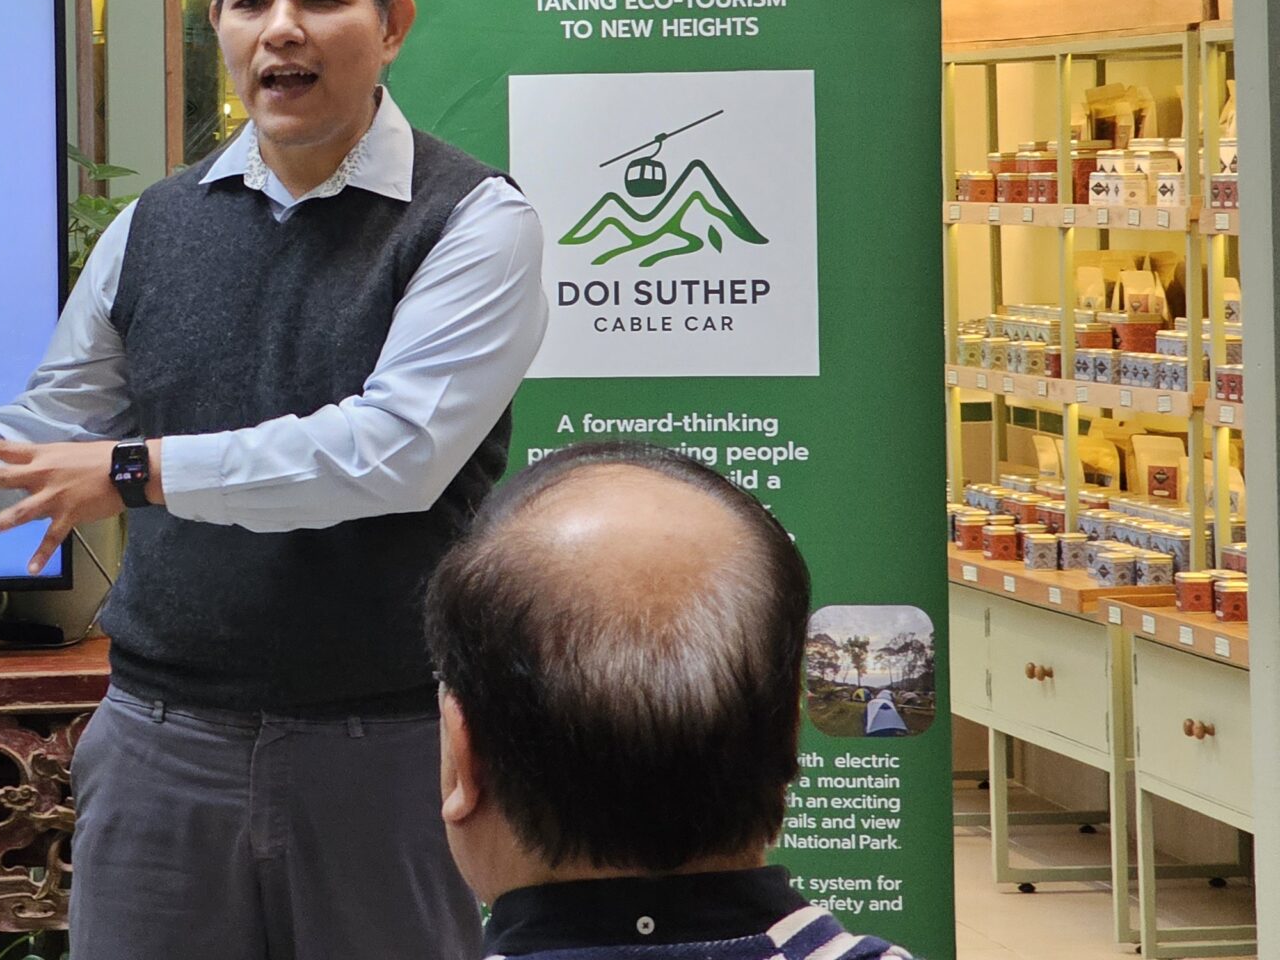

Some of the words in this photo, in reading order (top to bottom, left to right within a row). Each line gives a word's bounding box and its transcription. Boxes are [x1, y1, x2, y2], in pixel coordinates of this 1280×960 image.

[560, 20, 593, 39] TO
[601, 19, 654, 38] NEW
[662, 17, 759, 37] HEIGHTS
[558, 280, 620, 306] DOI
[634, 279, 771, 305] SUTHEP
[593, 316, 673, 332] CABLE
[684, 316, 734, 332] CAR
[557, 415, 574, 433] A
[583, 412, 779, 437] forward-thinking
[726, 441, 809, 465] people
[767, 473, 782, 490] a
[834, 753, 900, 768] electric
[799, 776, 811, 788] a
[817, 774, 900, 788] mountain
[806, 796, 828, 808] an
[831, 794, 901, 812] exciting
[782, 813, 817, 829] rails
[821, 814, 856, 829] and
[861, 815, 901, 829] view
[784, 833, 855, 849] National
[859, 834, 902, 850] Park.
[809, 877, 872, 893] system
[876, 875, 903, 890] for
[809, 895, 864, 914] safety
[869, 895, 903, 910] and
